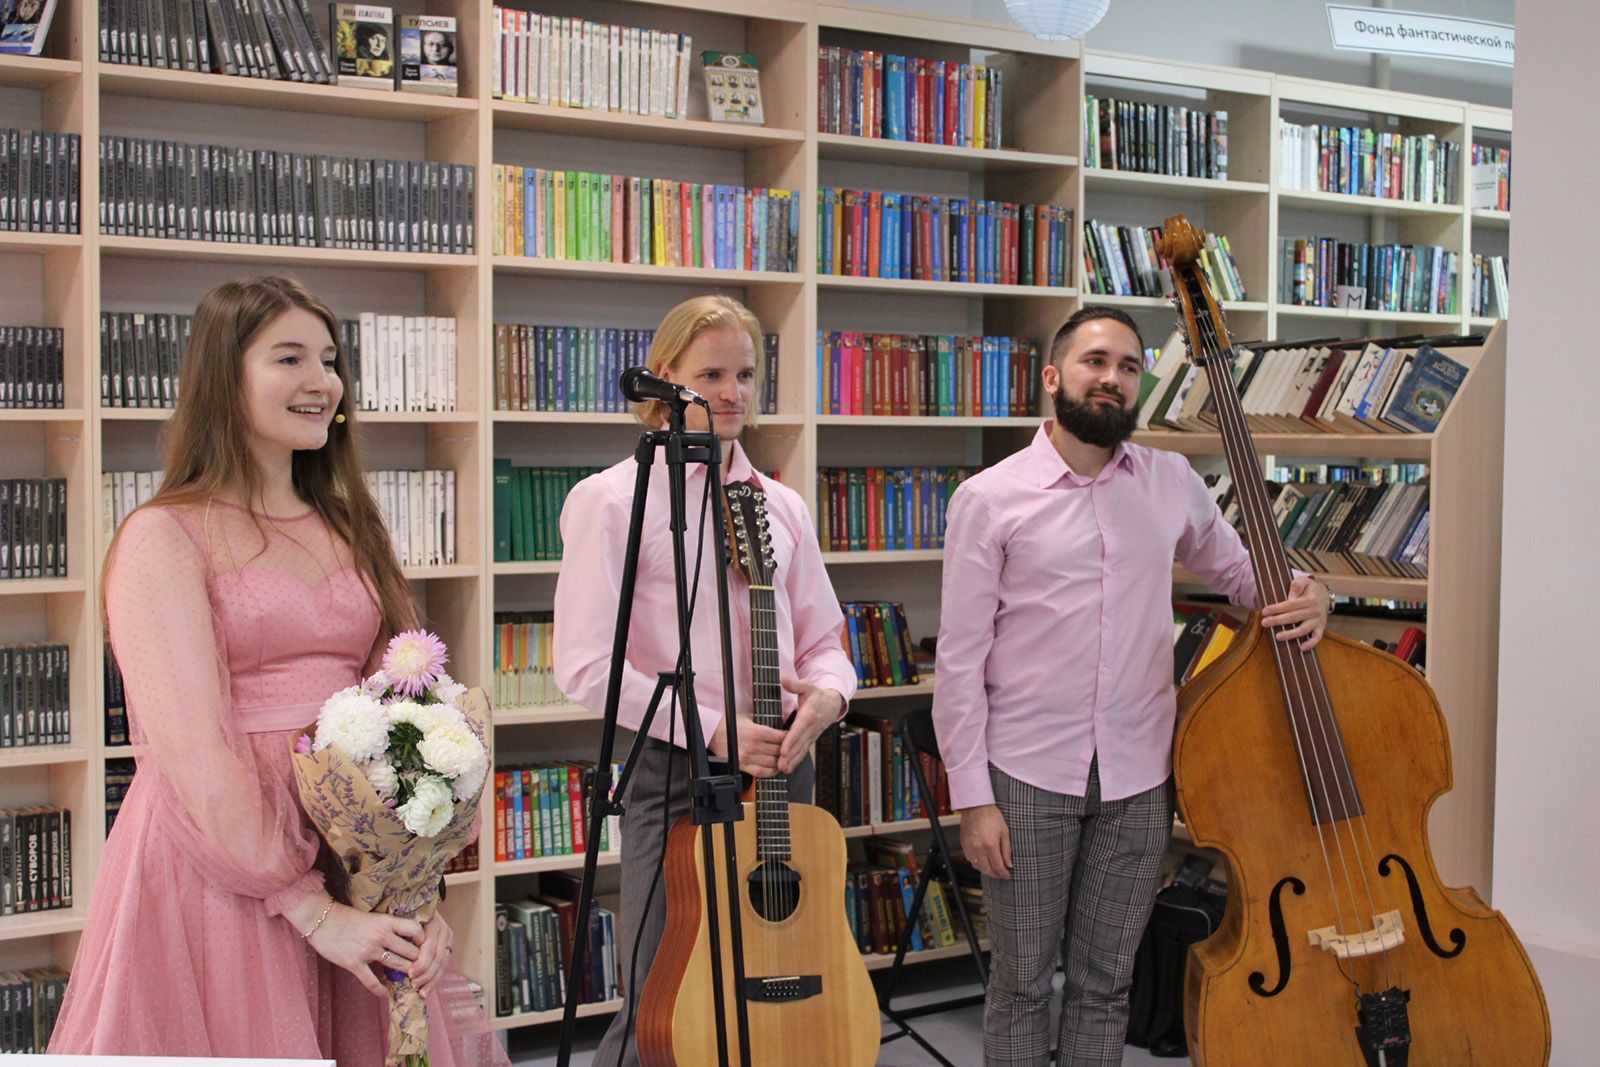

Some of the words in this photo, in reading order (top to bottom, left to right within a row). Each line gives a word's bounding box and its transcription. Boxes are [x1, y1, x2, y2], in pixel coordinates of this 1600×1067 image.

[408, 19, 448, 28] ТУПОЛЕВ
[1354, 20, 1395, 37] Фонд
[1397, 24, 1502, 47] фантастической
[29, 834, 38, 882] СУВОРОВ
